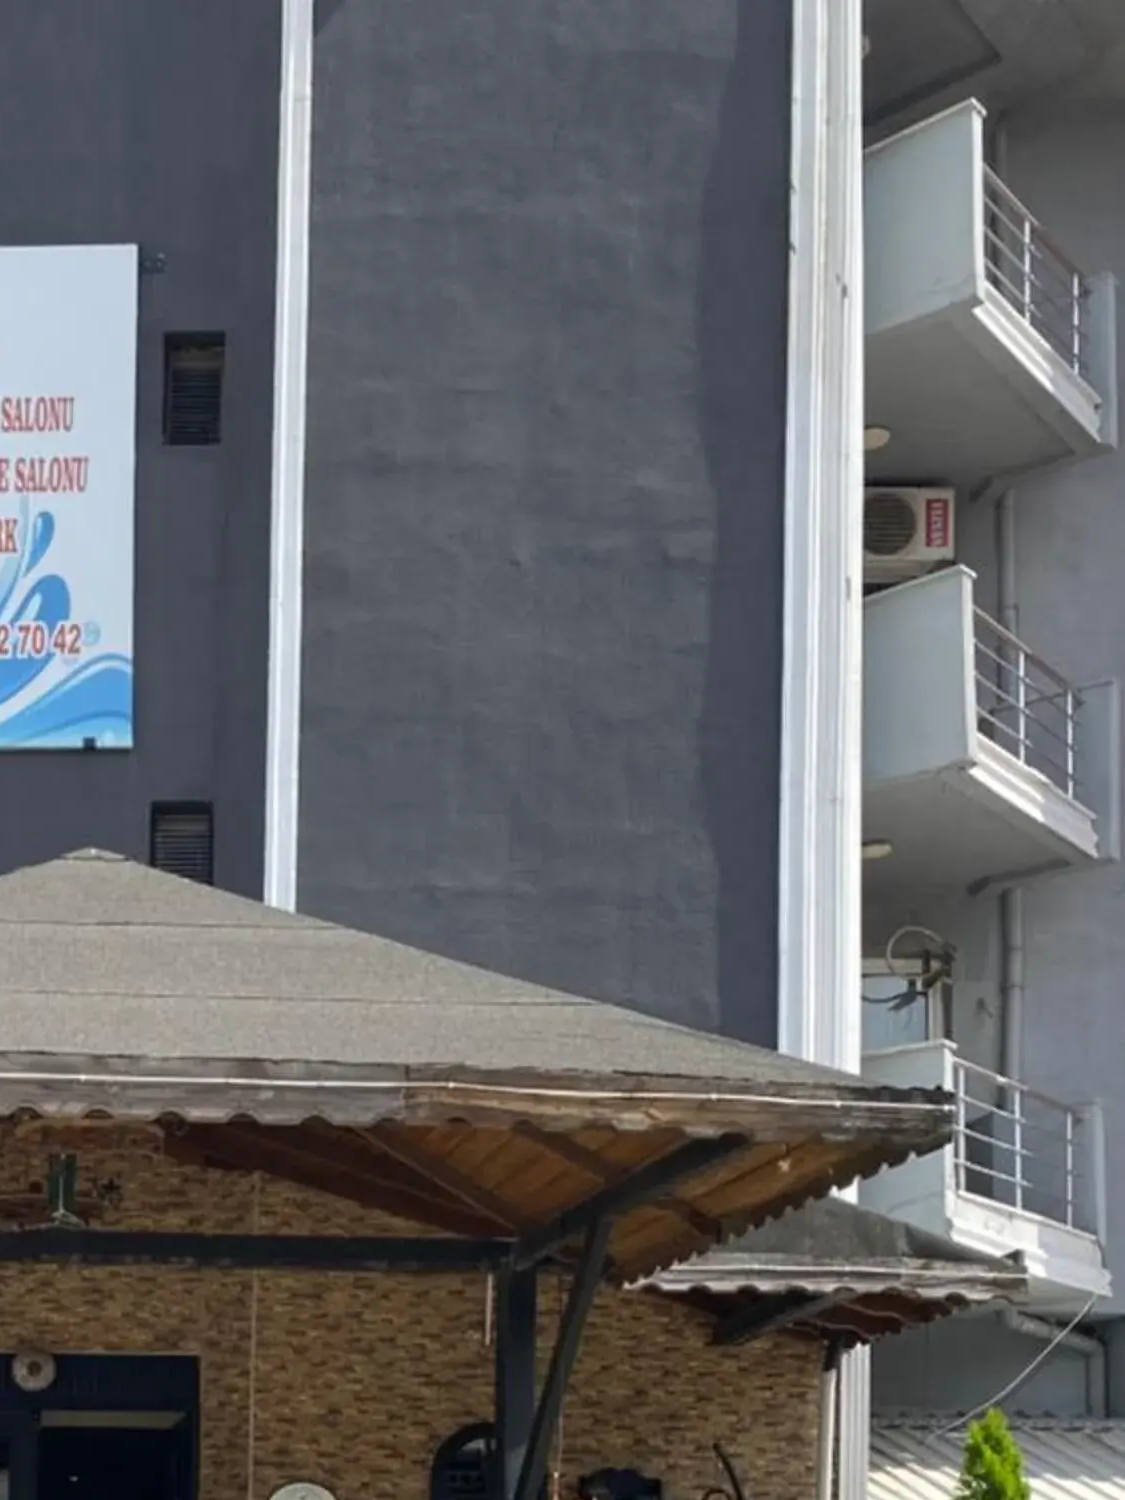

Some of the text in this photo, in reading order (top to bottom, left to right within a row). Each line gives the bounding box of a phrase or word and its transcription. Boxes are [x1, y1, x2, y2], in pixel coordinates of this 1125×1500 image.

[1, 396, 75, 432] SALONU
[14, 456, 89, 494] SALONU
[18, 624, 46, 656] 70
[53, 623, 81, 655] 42
